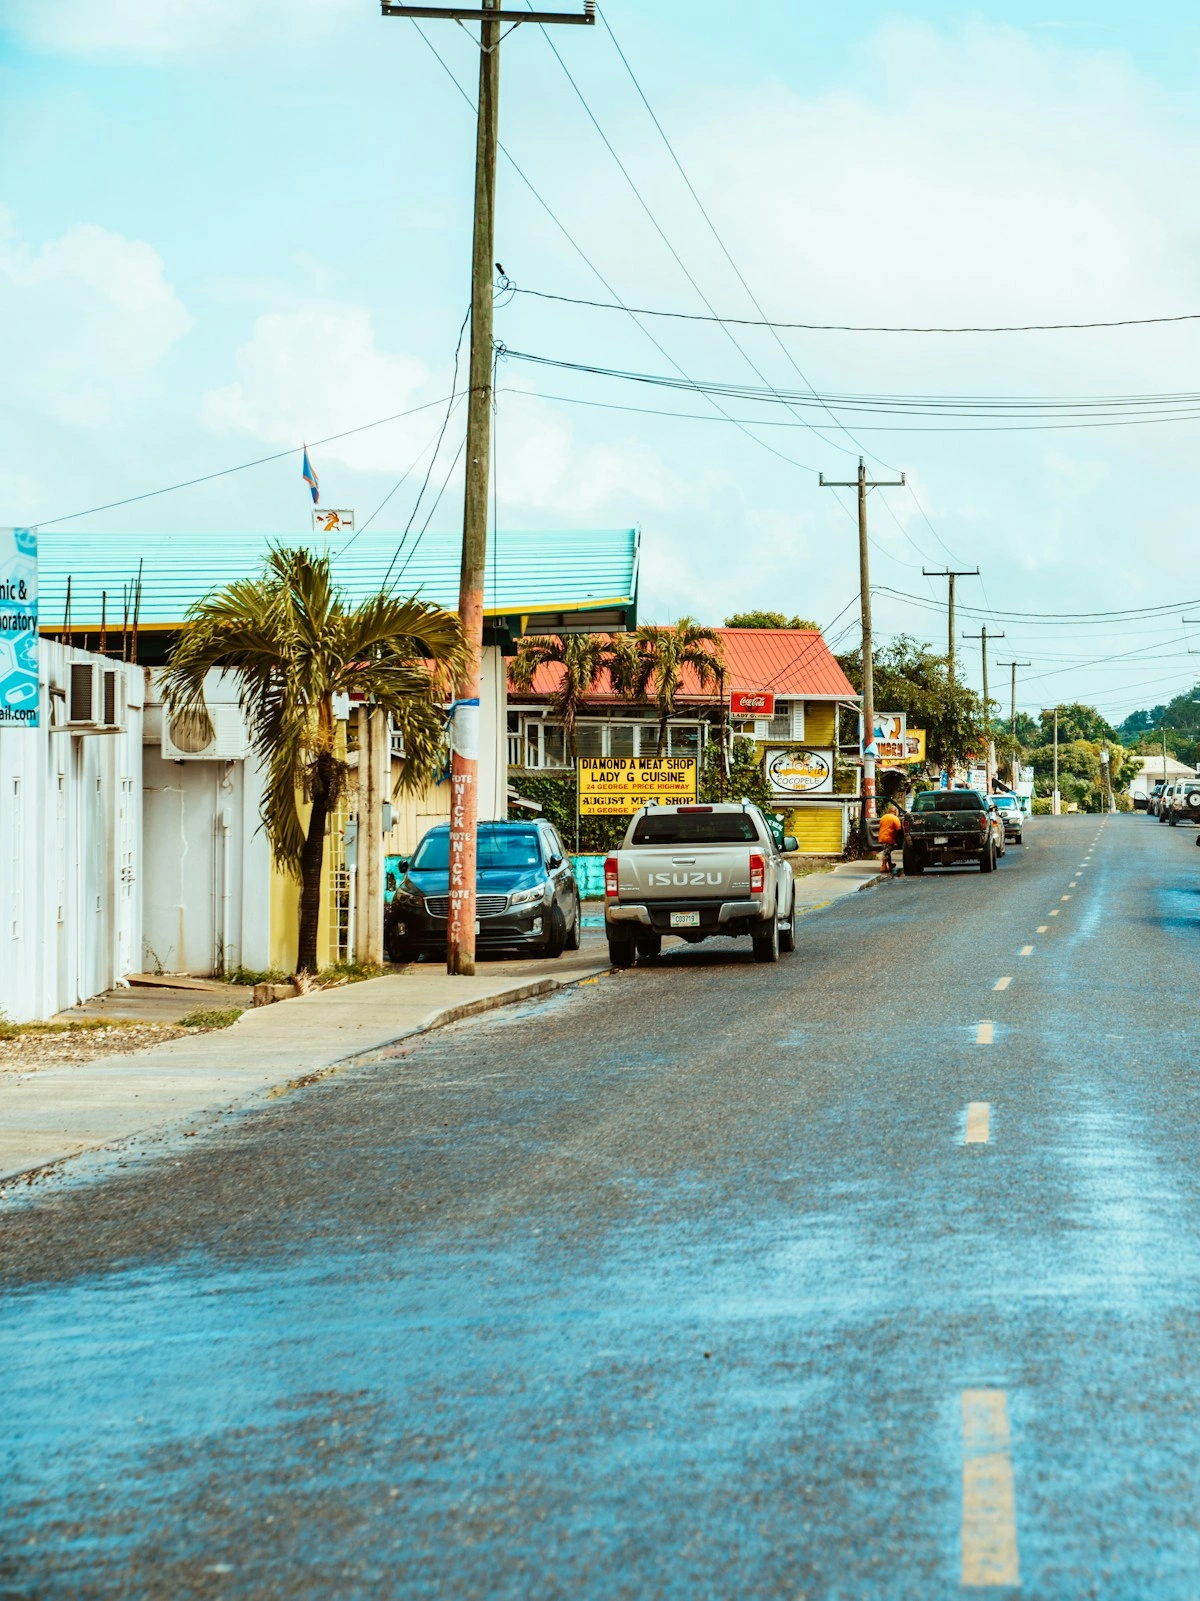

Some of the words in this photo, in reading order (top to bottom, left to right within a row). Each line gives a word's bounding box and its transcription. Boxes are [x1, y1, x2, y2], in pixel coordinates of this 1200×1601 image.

[18, 579, 27, 600] &
[0, 612, 37, 636] oratory
[740, 696, 765, 707] Coca-Cola
[582, 759, 627, 769] DIAMOND
[629, 759, 636, 769] A
[639, 759, 663, 769] MEAT
[667, 759, 694, 769] SHOP
[591, 772, 620, 782] LADY
[626, 772, 634, 782] G
[641, 772, 685, 782] CUISINE
[777, 777, 819, 785] COCOPELE
[454, 783, 465, 828] NICK
[583, 797, 625, 805] AUGUST
[665, 797, 694, 805] SHOP
[451, 841, 464, 886] NICK
[649, 872, 722, 886] ISUZU
[450, 899, 461, 943] NICK
